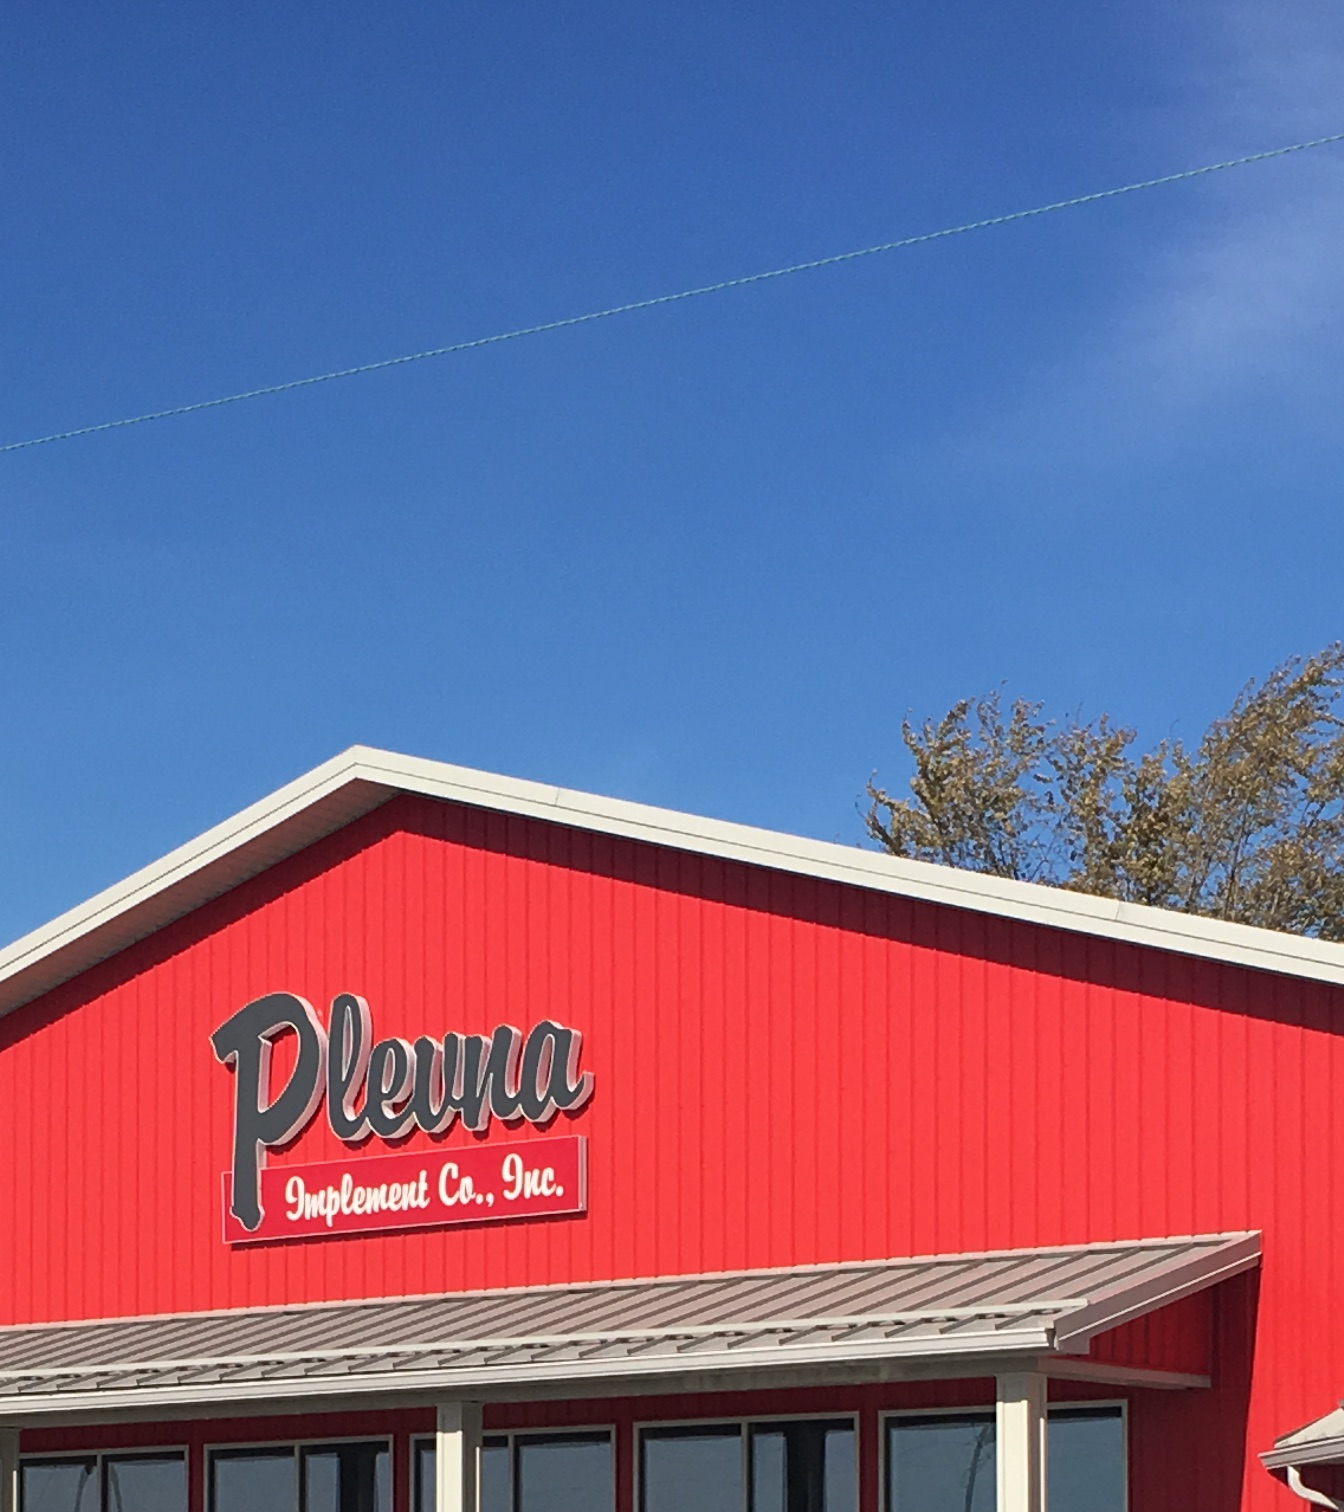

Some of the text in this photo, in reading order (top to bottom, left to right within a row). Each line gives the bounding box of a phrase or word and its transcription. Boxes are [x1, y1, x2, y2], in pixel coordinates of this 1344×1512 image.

[209, 991, 594, 1232] Plevna
[285, 1153, 564, 1227] Implement Co., Inc.
